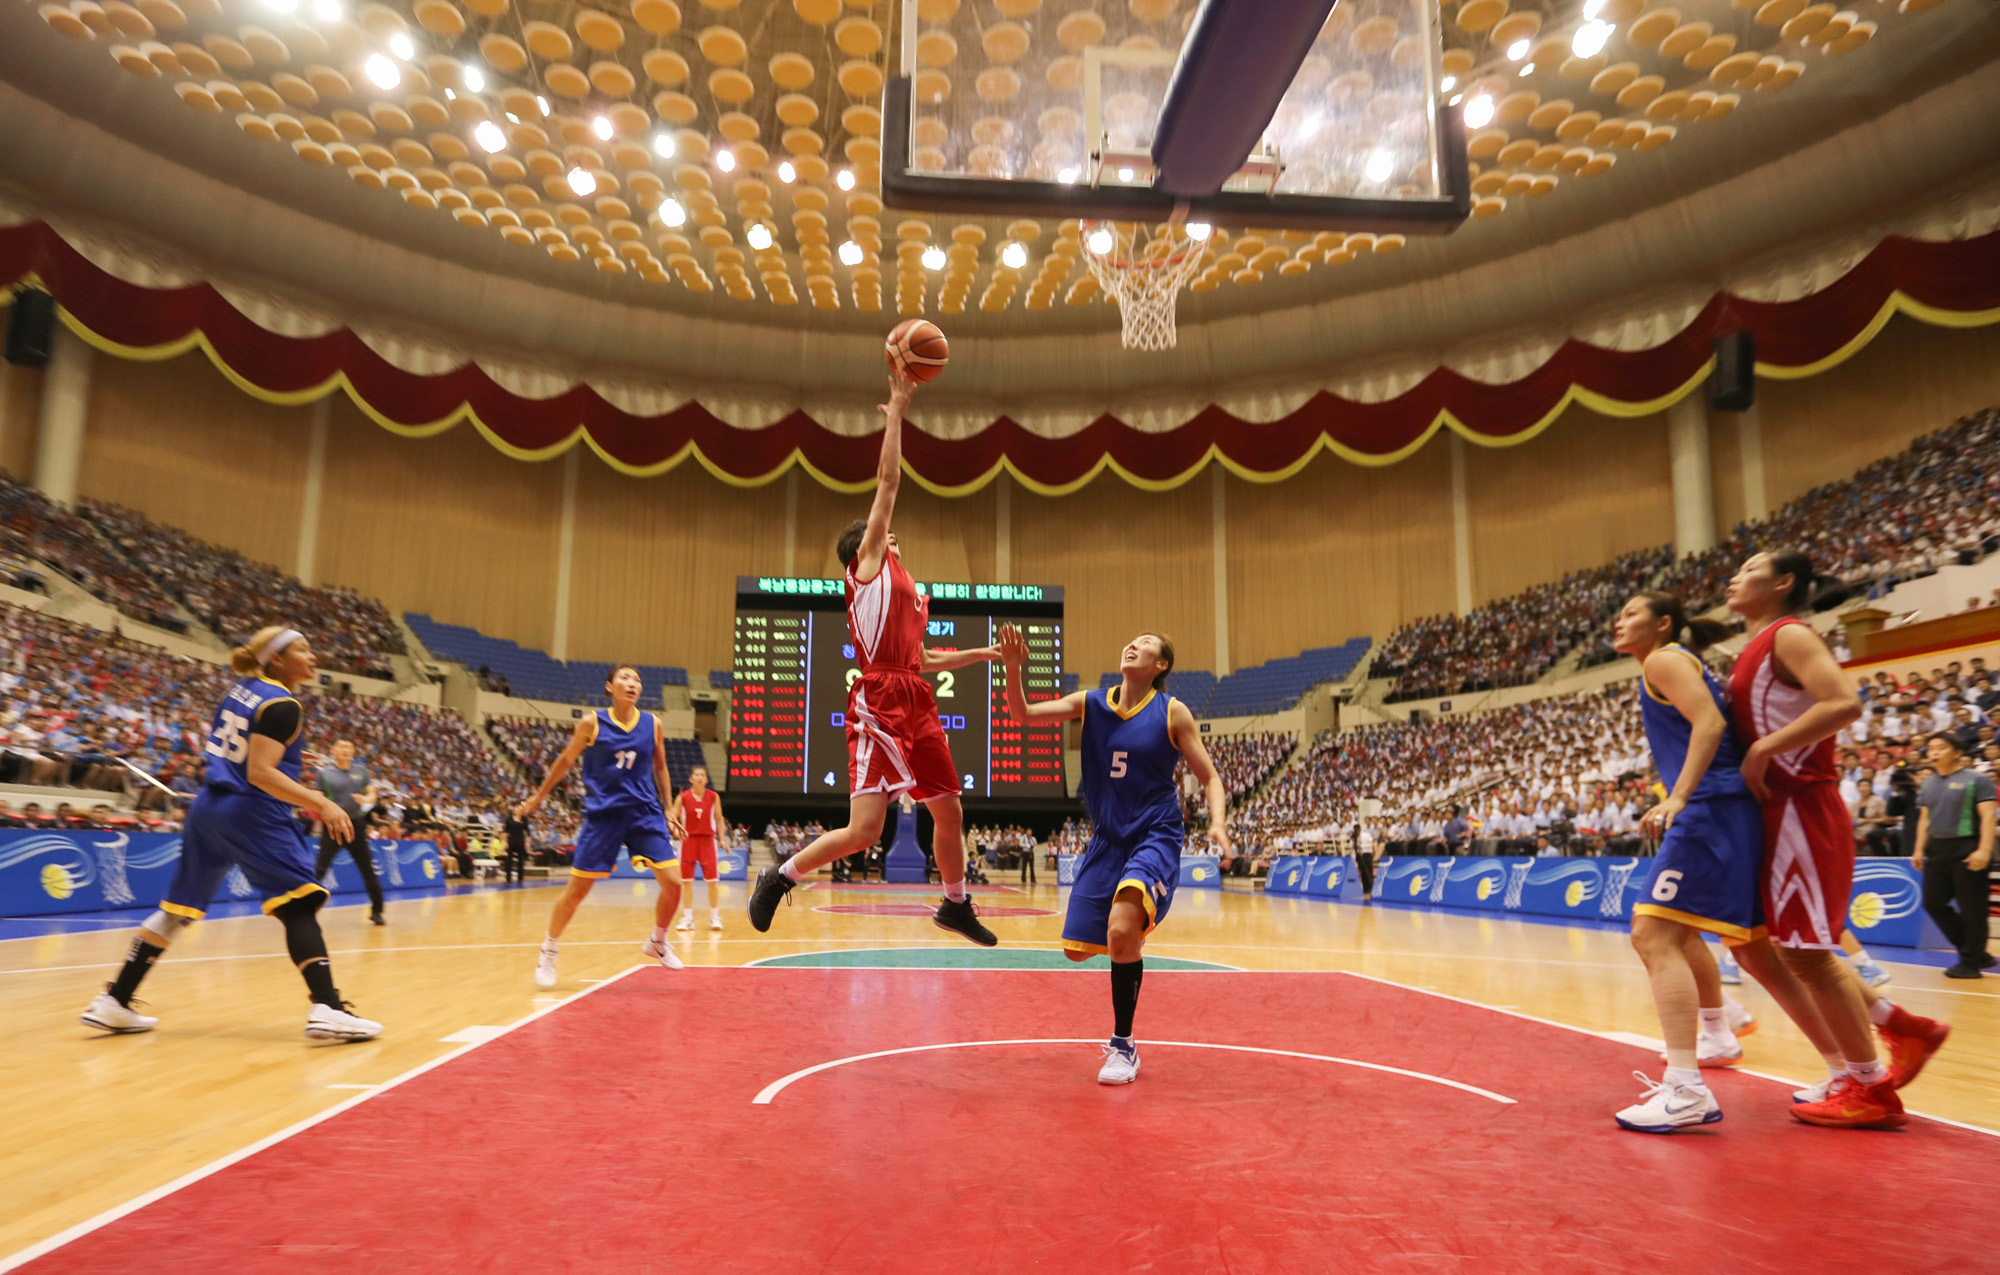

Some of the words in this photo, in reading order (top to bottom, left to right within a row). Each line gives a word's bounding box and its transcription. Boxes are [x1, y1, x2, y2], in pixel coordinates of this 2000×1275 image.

[926, 621, 955, 636] 경기
[1054, 625, 1060, 635] 0
[1054, 638, 1060, 648] 0
[1054, 651, 1060, 661] 0
[1054, 665, 1060, 675] 0
[936, 670, 955, 698] 2
[205, 709, 249, 764] 35
[614, 750, 637, 770] 11
[1110, 751, 1128, 779] 5
[823, 771, 836, 787] 4
[963, 774, 975, 789] 2
[1651, 869, 1684, 902] 6
